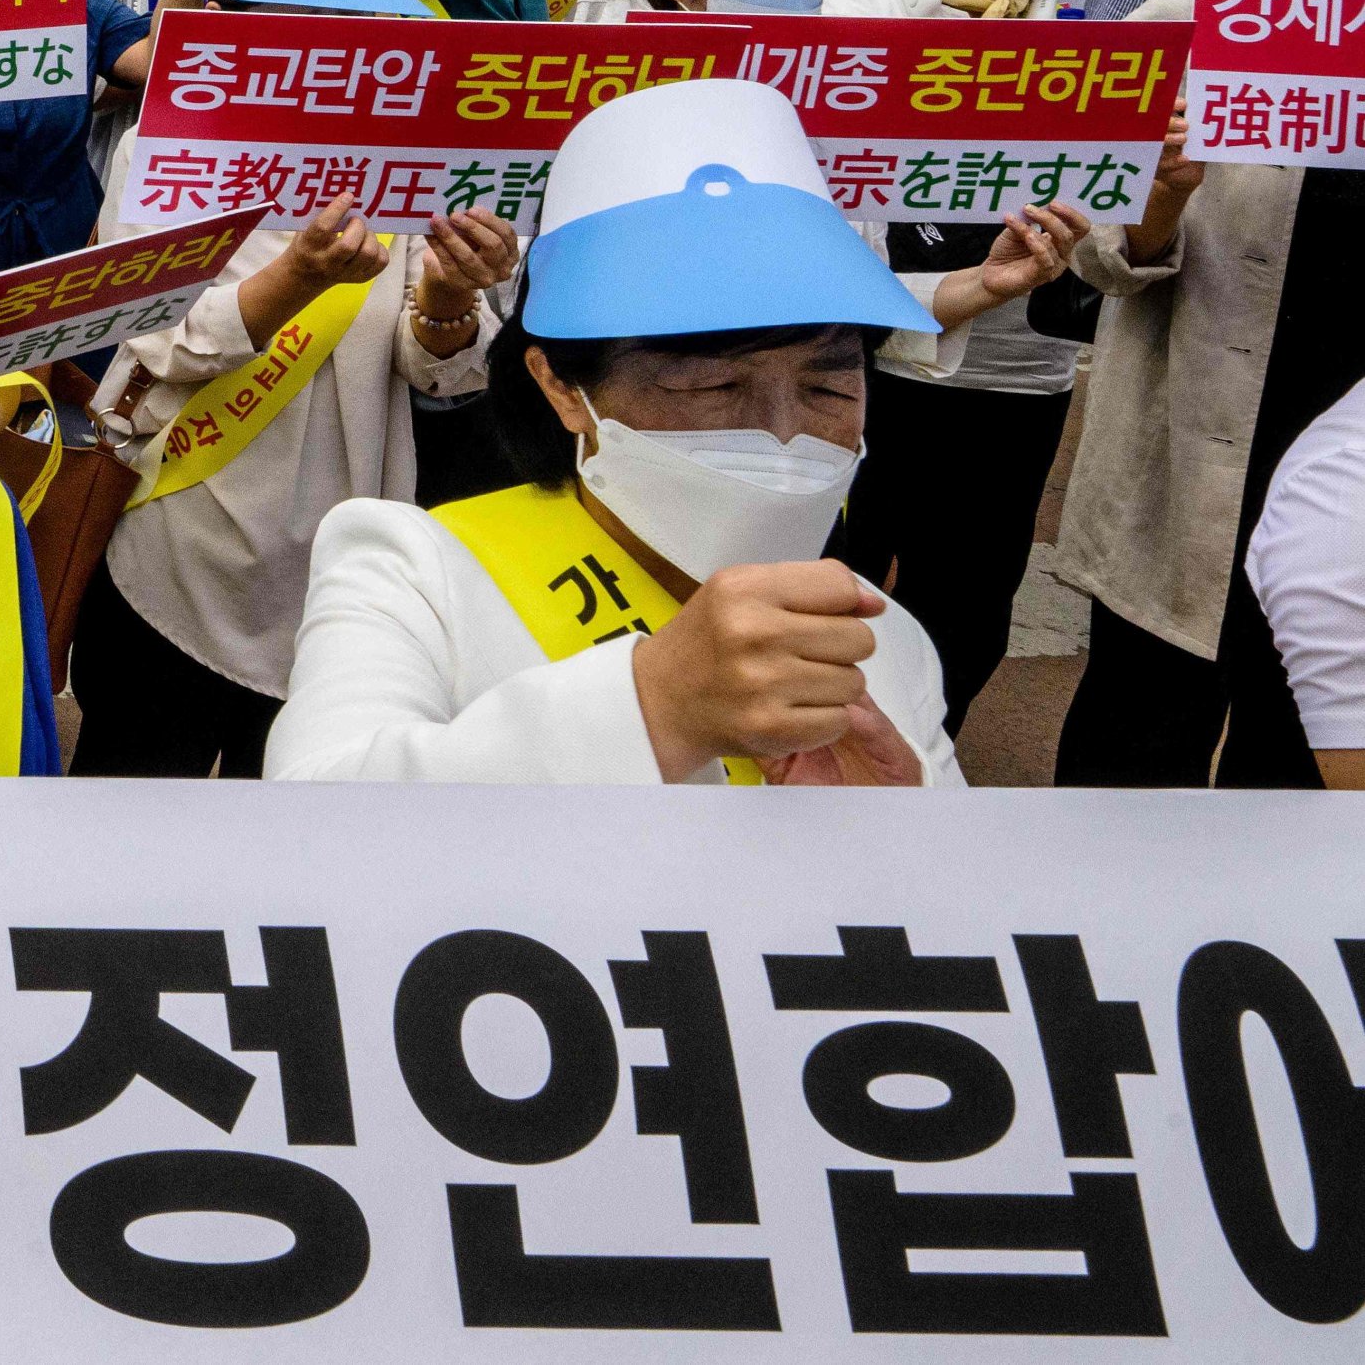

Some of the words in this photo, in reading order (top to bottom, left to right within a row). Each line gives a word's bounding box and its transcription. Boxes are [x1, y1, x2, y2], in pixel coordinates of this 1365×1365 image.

[167, 41, 441, 117] 종교탄압
[908, 48, 1168, 113] 중단하라
[547, 553, 654, 646] 가
